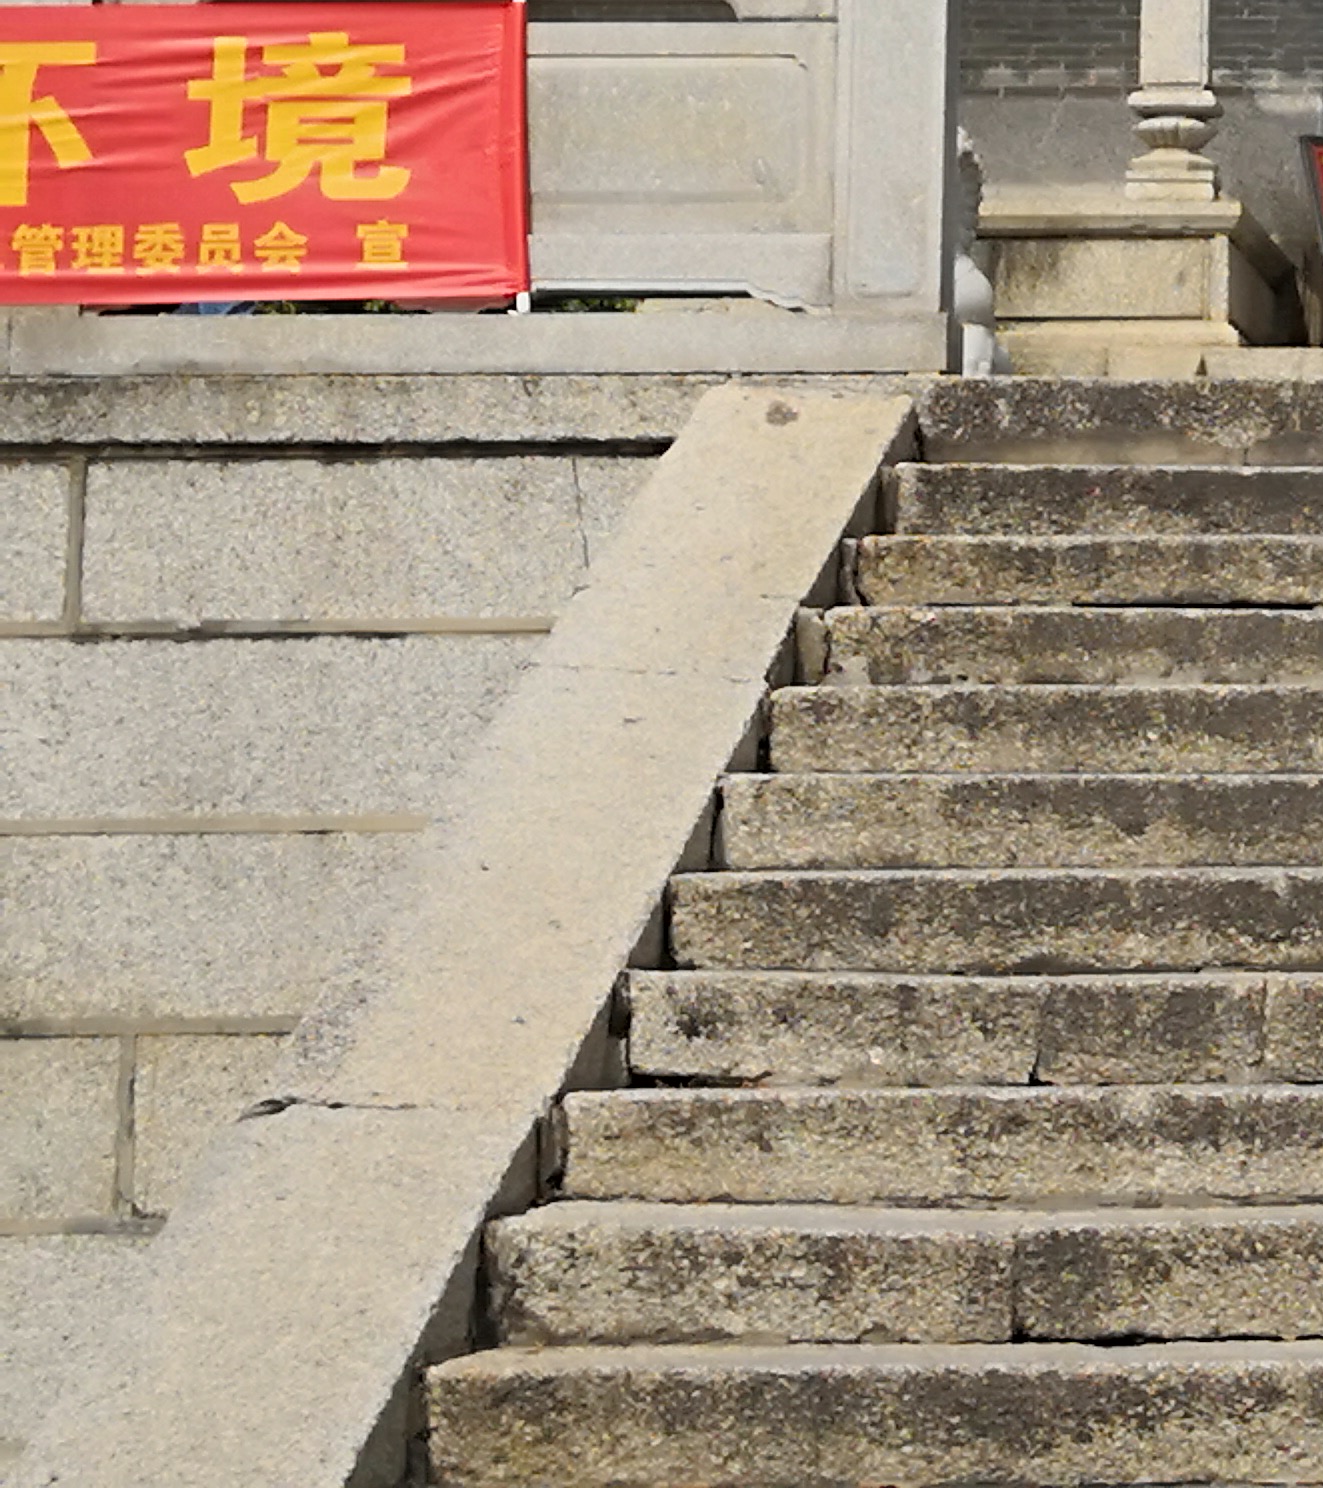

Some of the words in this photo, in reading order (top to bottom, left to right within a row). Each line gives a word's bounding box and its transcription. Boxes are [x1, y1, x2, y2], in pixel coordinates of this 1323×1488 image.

[10, 220, 309, 277] 管理委员会
[354, 218, 411, 272] 宣
